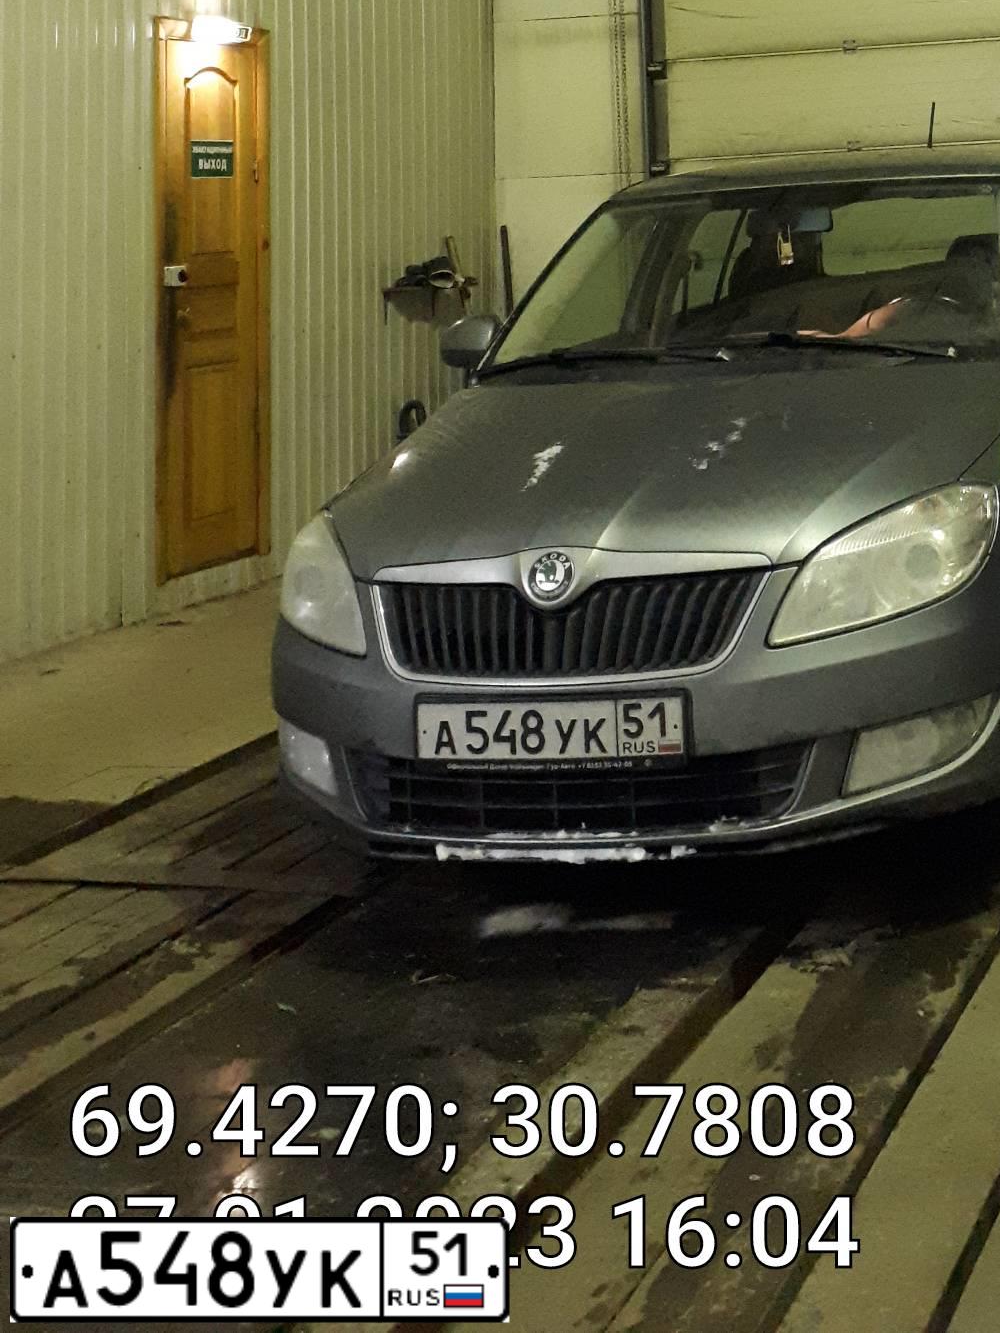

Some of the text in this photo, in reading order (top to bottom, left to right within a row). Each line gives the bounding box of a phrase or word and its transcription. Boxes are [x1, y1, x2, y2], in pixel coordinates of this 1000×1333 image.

[198, 158, 227, 171] ВЫХОД
[434, 702, 667, 755] А548УК 51
[622, 740, 656, 754] RUS
